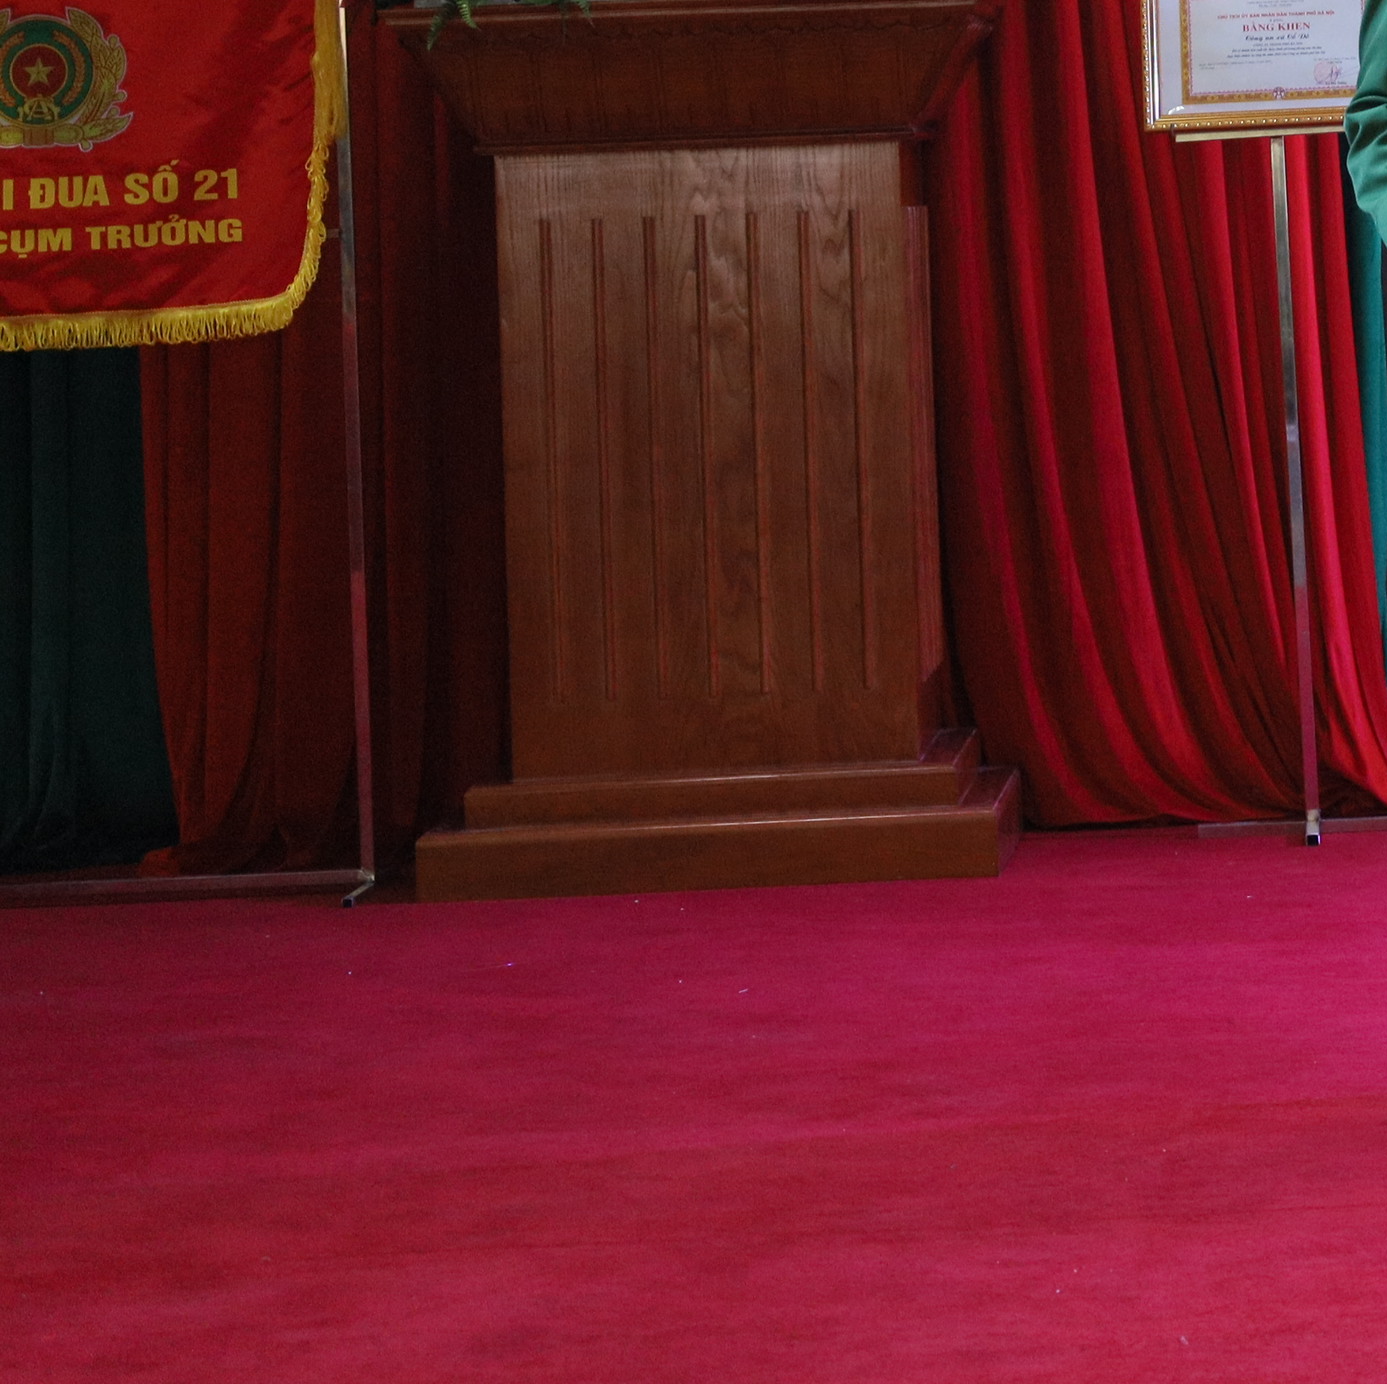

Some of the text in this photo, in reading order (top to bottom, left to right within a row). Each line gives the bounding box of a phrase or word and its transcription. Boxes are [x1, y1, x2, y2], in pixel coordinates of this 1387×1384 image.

[1278, 22, 1310, 31] KHEN
[28, 175, 110, 209] ĐUA
[123, 159, 179, 205] SỐ
[194, 168, 238, 201] 21
[85, 215, 243, 250] TRƯỞNG
